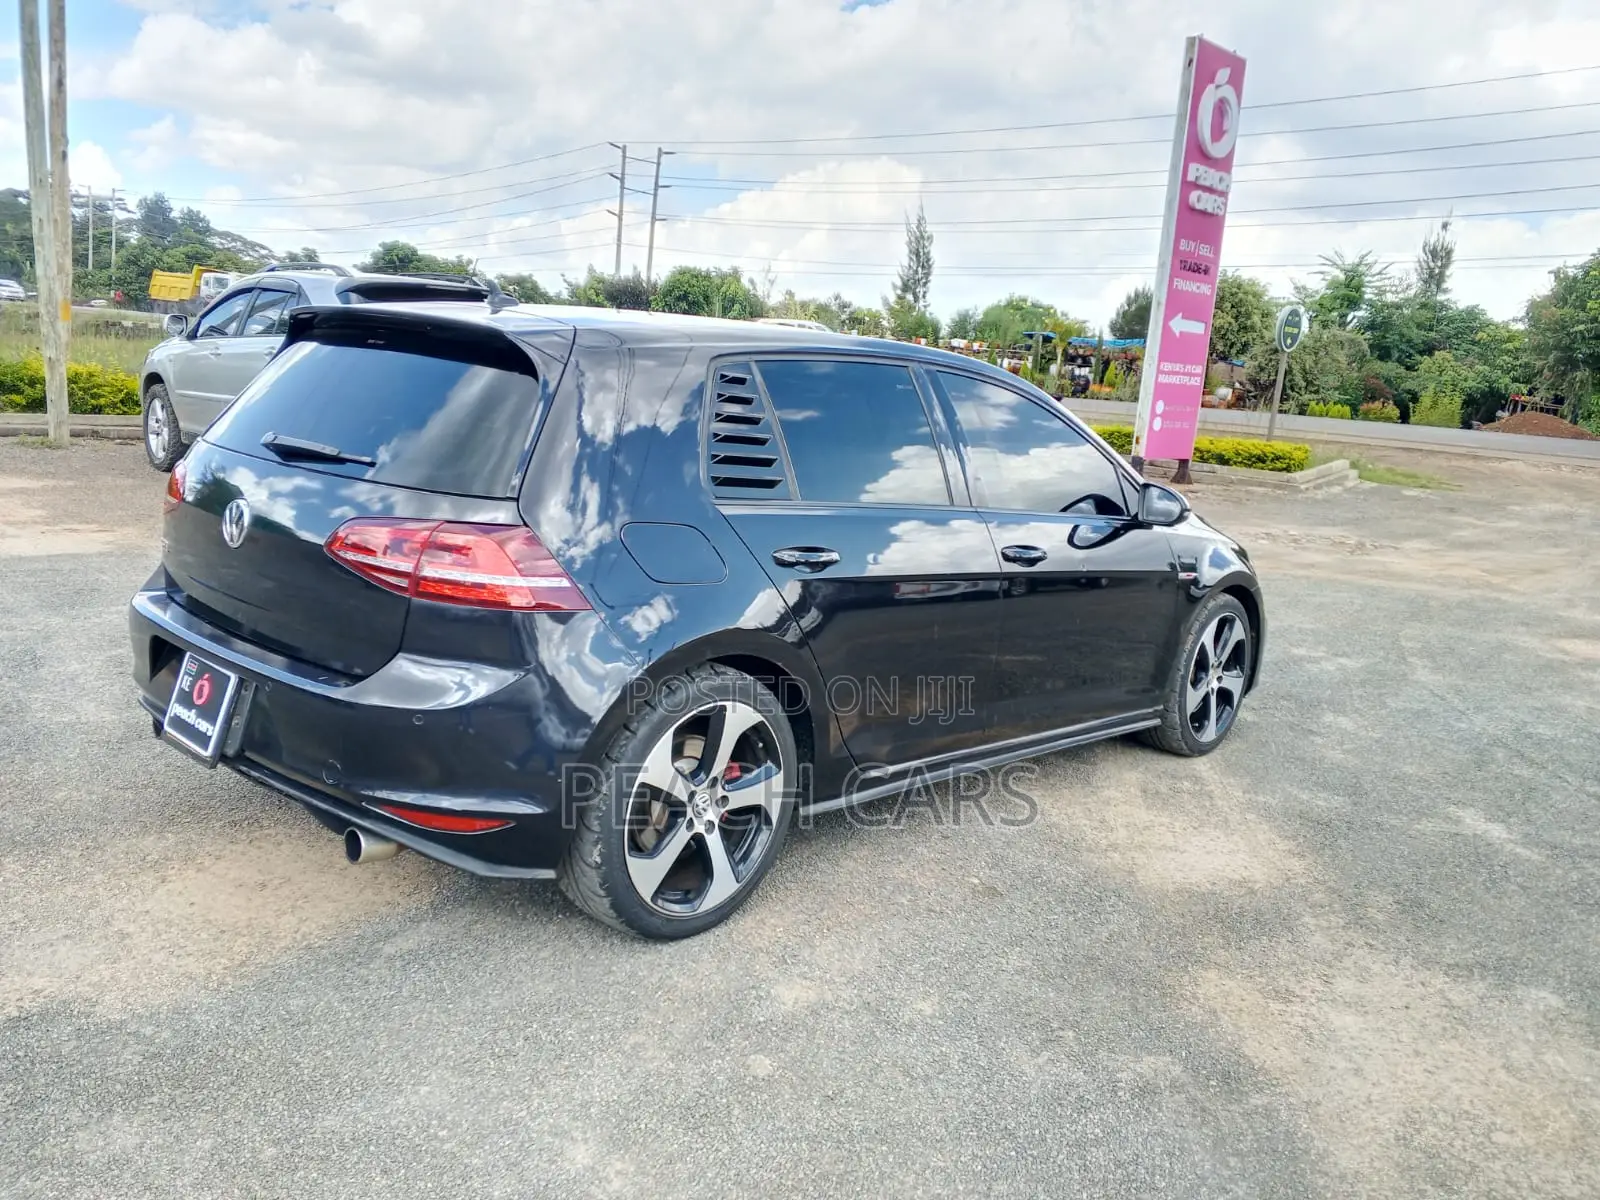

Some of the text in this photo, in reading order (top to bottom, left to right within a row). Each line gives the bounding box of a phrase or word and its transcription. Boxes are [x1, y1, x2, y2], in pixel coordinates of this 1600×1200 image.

[1189, 190, 1226, 216] CARS
[1173, 277, 1212, 297] FINANCING
[1158, 373, 1201, 387] MARKETPLACE
[181, 674, 193, 692] KE
[170, 702, 214, 737] peach cars
